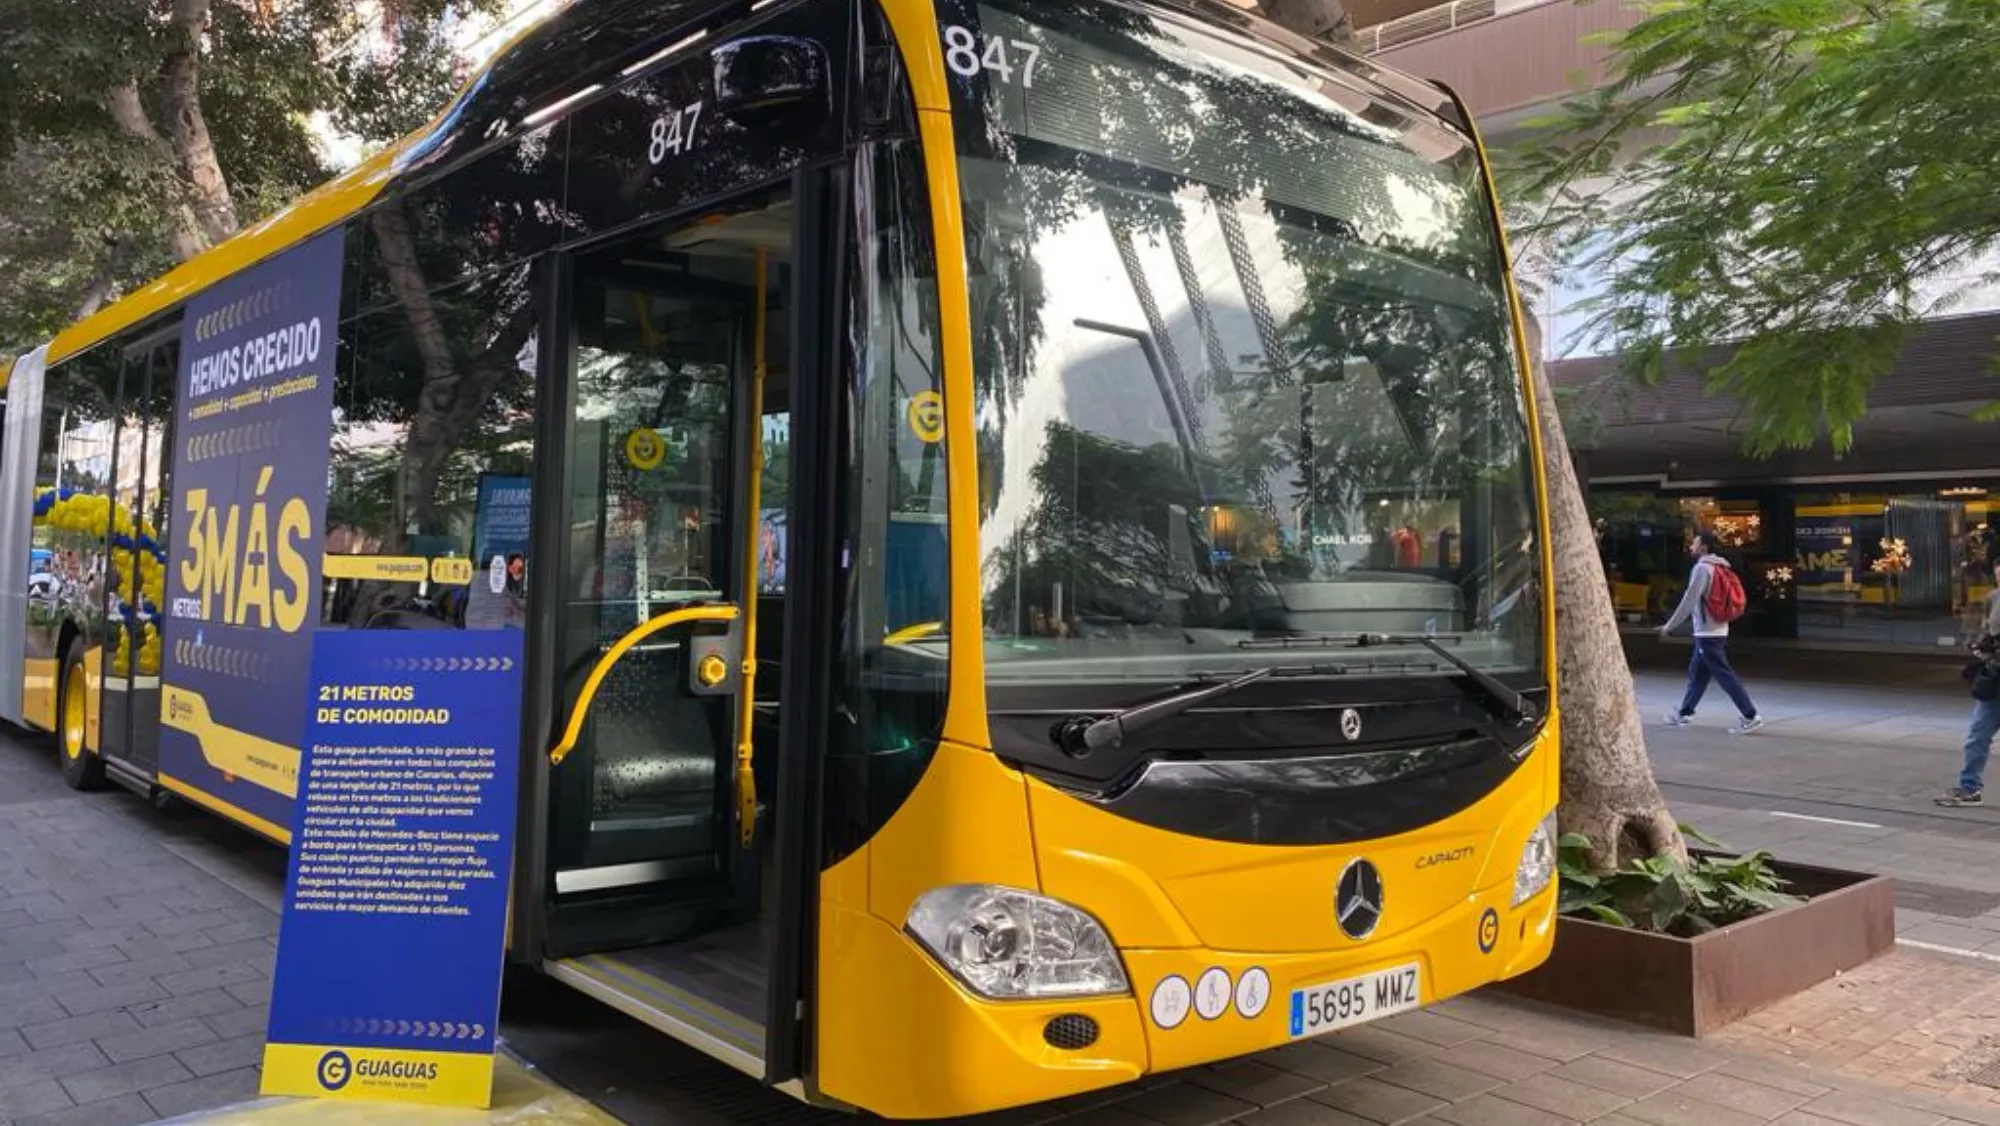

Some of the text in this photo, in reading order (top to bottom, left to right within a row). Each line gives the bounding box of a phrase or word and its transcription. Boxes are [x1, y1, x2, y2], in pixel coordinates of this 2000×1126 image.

[945, 26, 1040, 88] 847
[649, 102, 702, 164] 847
[189, 317, 320, 398] HEMOS CRECIDO
[172, 598, 202, 619] METROS
[319, 686, 414, 701] 21 METROS
[317, 708, 450, 724] DE COMODIDAD
[333, 747, 365, 755] guagua
[444, 747, 476, 756] grande
[407, 758, 431, 766] todas
[323, 769, 369, 779] transporte
[458, 771, 493, 780] dispone
[339, 782, 375, 791] longitud
[436, 784, 451, 792] por
[424, 795, 481, 803] tradicionales
[380, 806, 425, 815] capacidad
[427, 808, 442, 816] que
[371, 830, 439, 838] Mercedes-Benz
[465, 832, 500, 841] espacio
[357, 842, 408, 851] transportar
[433, 845, 475, 853] personas.
[300, 853, 316, 861] Sus
[349, 854, 382, 864] puertas
[384, 855, 425, 864] permiten
[438, 856, 465, 865] mejor
[466, 857, 487, 866] flujo
[312, 865, 346, 873] entrada
[354, 866, 380, 874] salida
[394, 867, 428, 876] viajeros
[458, 868, 495, 878] paradas.
[298, 878, 336, 887] Guaguas
[337, 878, 389, 888] Municipales
[403, 880, 445, 889] adquirido
[296, 890, 336, 898] unidades
[337, 892, 353, 900] que
[374, 892, 422, 900] destinadas
[294, 902, 334, 910] servicios
[348, 905, 376, 913] mayor
[376, 904, 418, 912] demanda
[432, 905, 470, 913] clientes.
[1308, 969, 1416, 1027] 5695 MMZ
[356, 1058, 438, 1080] GUAGUAS
